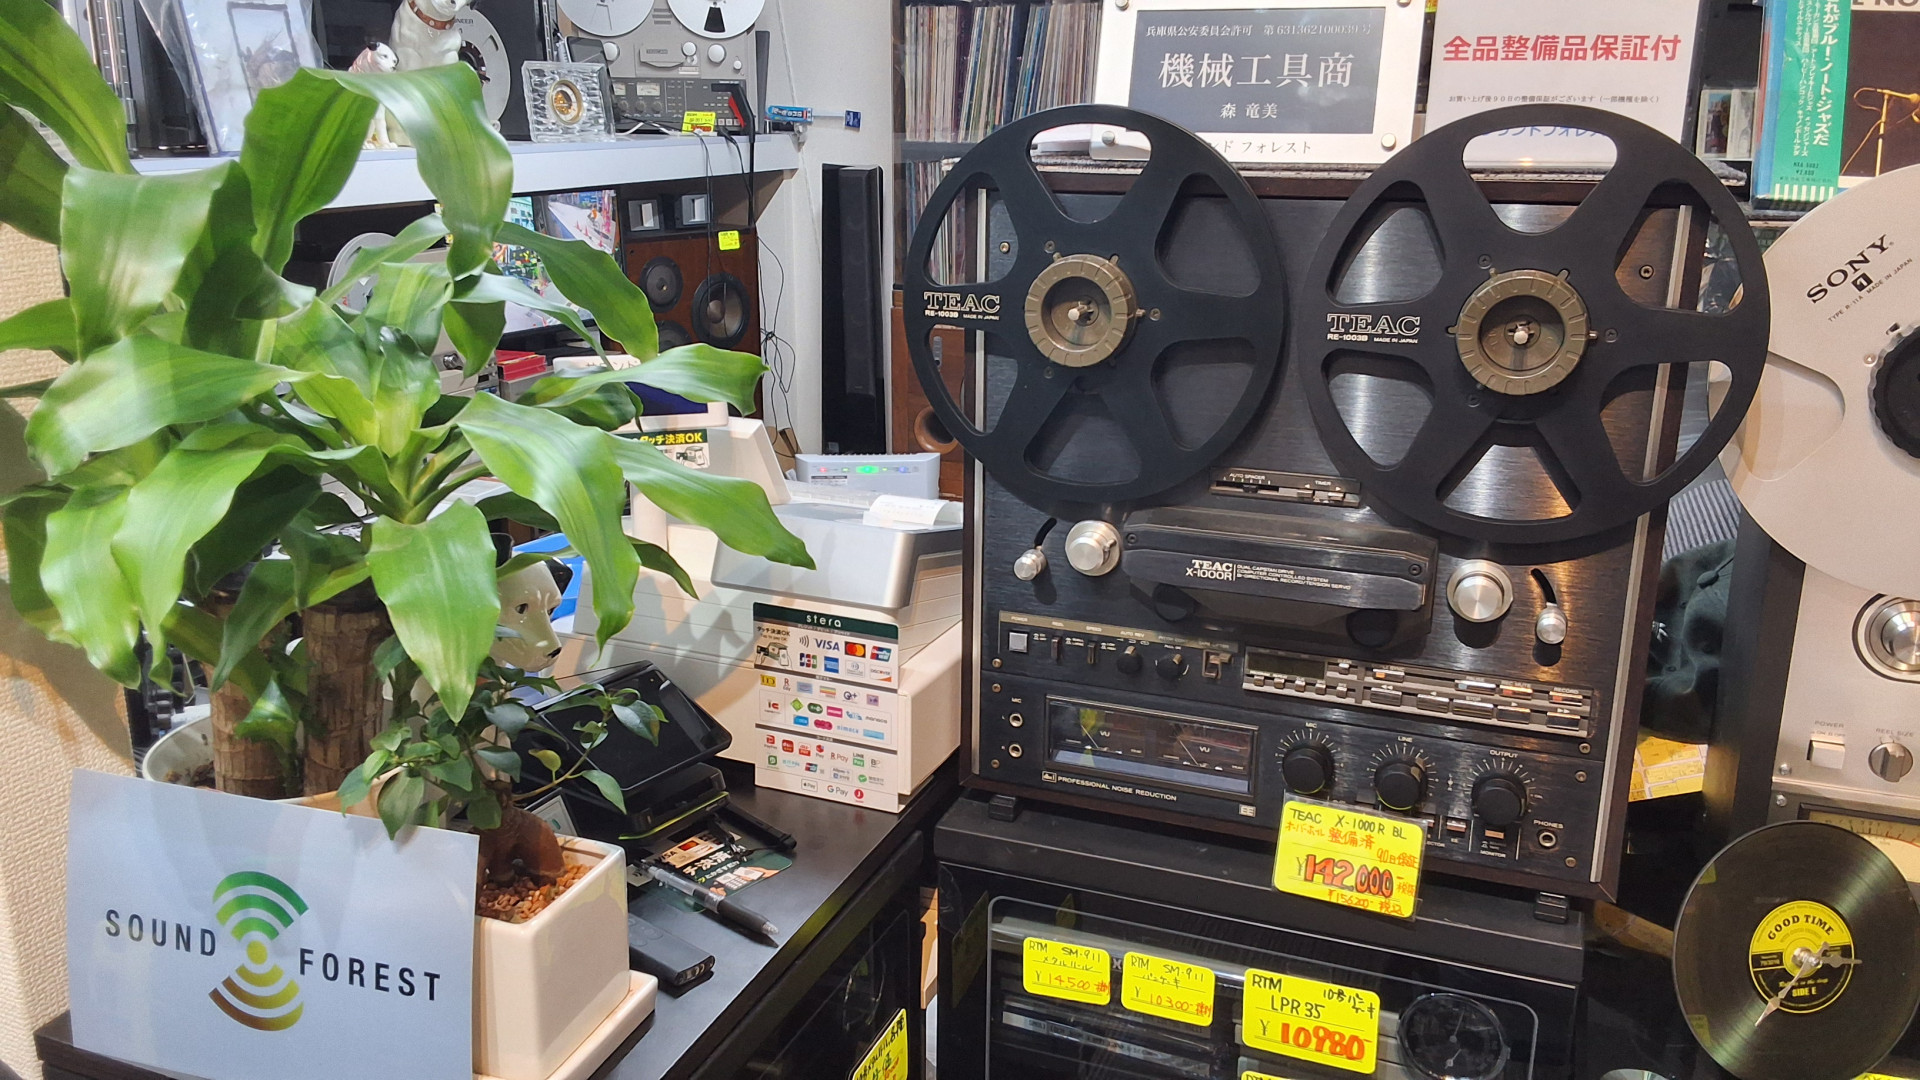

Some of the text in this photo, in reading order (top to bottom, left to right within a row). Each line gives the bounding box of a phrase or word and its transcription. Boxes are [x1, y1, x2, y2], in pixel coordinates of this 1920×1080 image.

[1146, 25, 1253, 37] 兵庫県公安委員会許可
[1443, 34, 1682, 62] 全品整備品保証付
[1158, 51, 1355, 89] 機械工具商
[1812, 0, 1842, 146] れがブルー・ノート・ジャズだ
[1219, 102, 1237, 119] 森
[1242, 140, 1313, 154] フォレスト
[1806, 234, 1889, 304] SONY
[1828, 310, 1844, 322] TYPE
[1866, 281, 1884, 294] MADE
[1894, 258, 1913, 275] JAPAN
[923, 291, 1000, 314] TEAC
[925, 309, 959, 318] RE-1003B
[1327, 313, 1420, 336] TEAC
[1327, 333, 1369, 341] RE-1003B
[1192, 559, 1233, 572] TEAC
[1185, 567, 1233, 581] X-1000R
[806, 614, 842, 628] stera
[814, 638, 840, 651] VISA
[1553, 687, 1579, 695] RECORD
[1814, 720, 1844, 728] POWER
[1397, 735, 1413, 743] LINE
[1489, 749, 1519, 759] OUTPUT
[835, 787, 849, 797] Pay
[1058, 776, 1110, 790] PROFESSIONAL
[1111, 785, 1133, 794] NOISE
[1135, 788, 1177, 801] REDUCTION
[1290, 808, 1407, 840] TEAC X-1000R BL
[1533, 819, 1564, 829] PHONES
[1480, 850, 1507, 858] MONITOR
[1768, 915, 1800, 940] GOOD
[1804, 914, 1834, 936] TIME
[1029, 940, 1048, 953] RTM
[105, 909, 441, 1002] SOUND FOREST
[1131, 955, 1150, 969] RTM
[1252, 974, 1282, 992] RTM
[1792, 988, 1810, 997] SIDE
